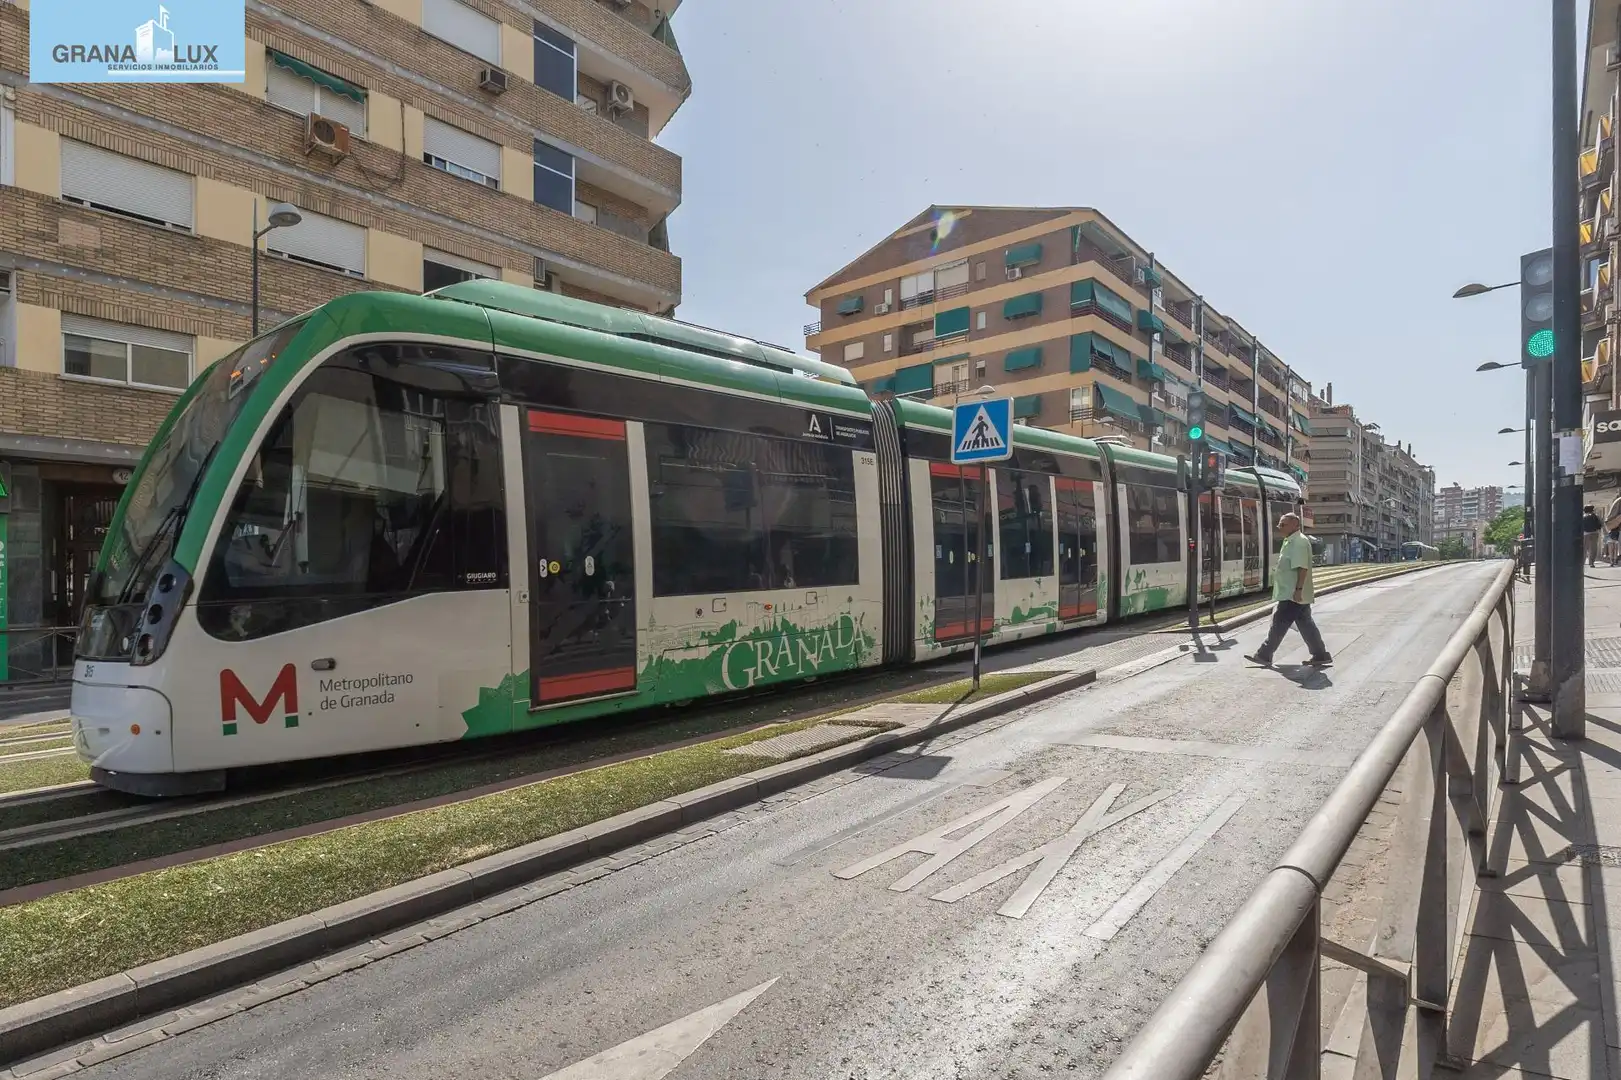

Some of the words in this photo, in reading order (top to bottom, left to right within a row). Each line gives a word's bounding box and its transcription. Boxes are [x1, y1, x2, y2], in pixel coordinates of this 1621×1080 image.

[721, 612, 870, 690] GRANADA
[219, 662, 299, 736] M
[319, 672, 414, 693] Metropolitano
[320, 697, 338, 711] de
[340, 689, 396, 708] Granada
